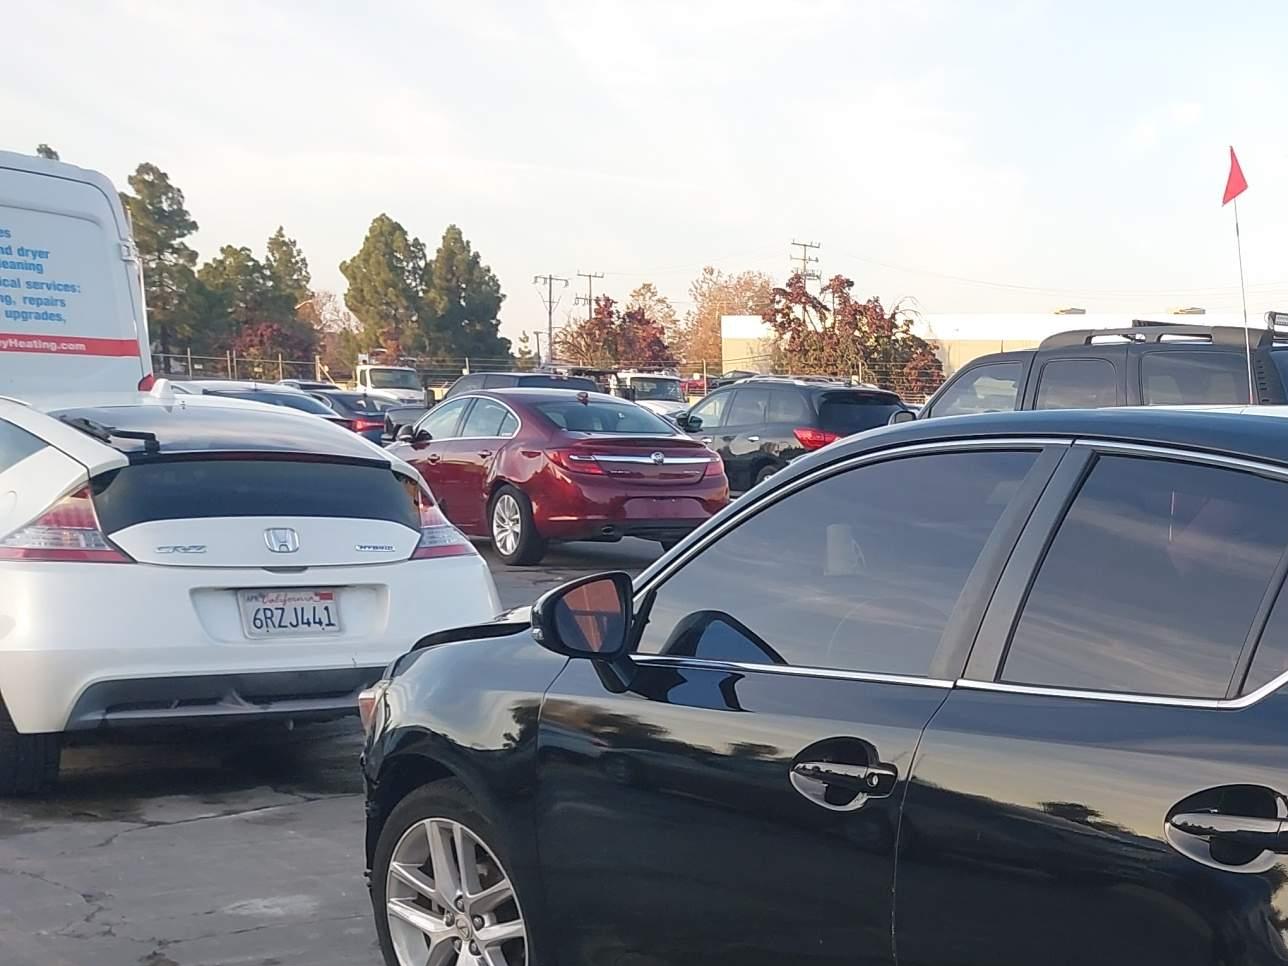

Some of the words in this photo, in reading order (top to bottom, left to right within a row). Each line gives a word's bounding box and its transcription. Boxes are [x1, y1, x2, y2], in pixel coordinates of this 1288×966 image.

[17, 246, 50, 260] dryer
[26, 280, 81, 293] services:
[23, 295, 66, 308] repairs
[4, 309, 66, 324] upgrades,
[253, 605, 337, 630] 6RZJ441
